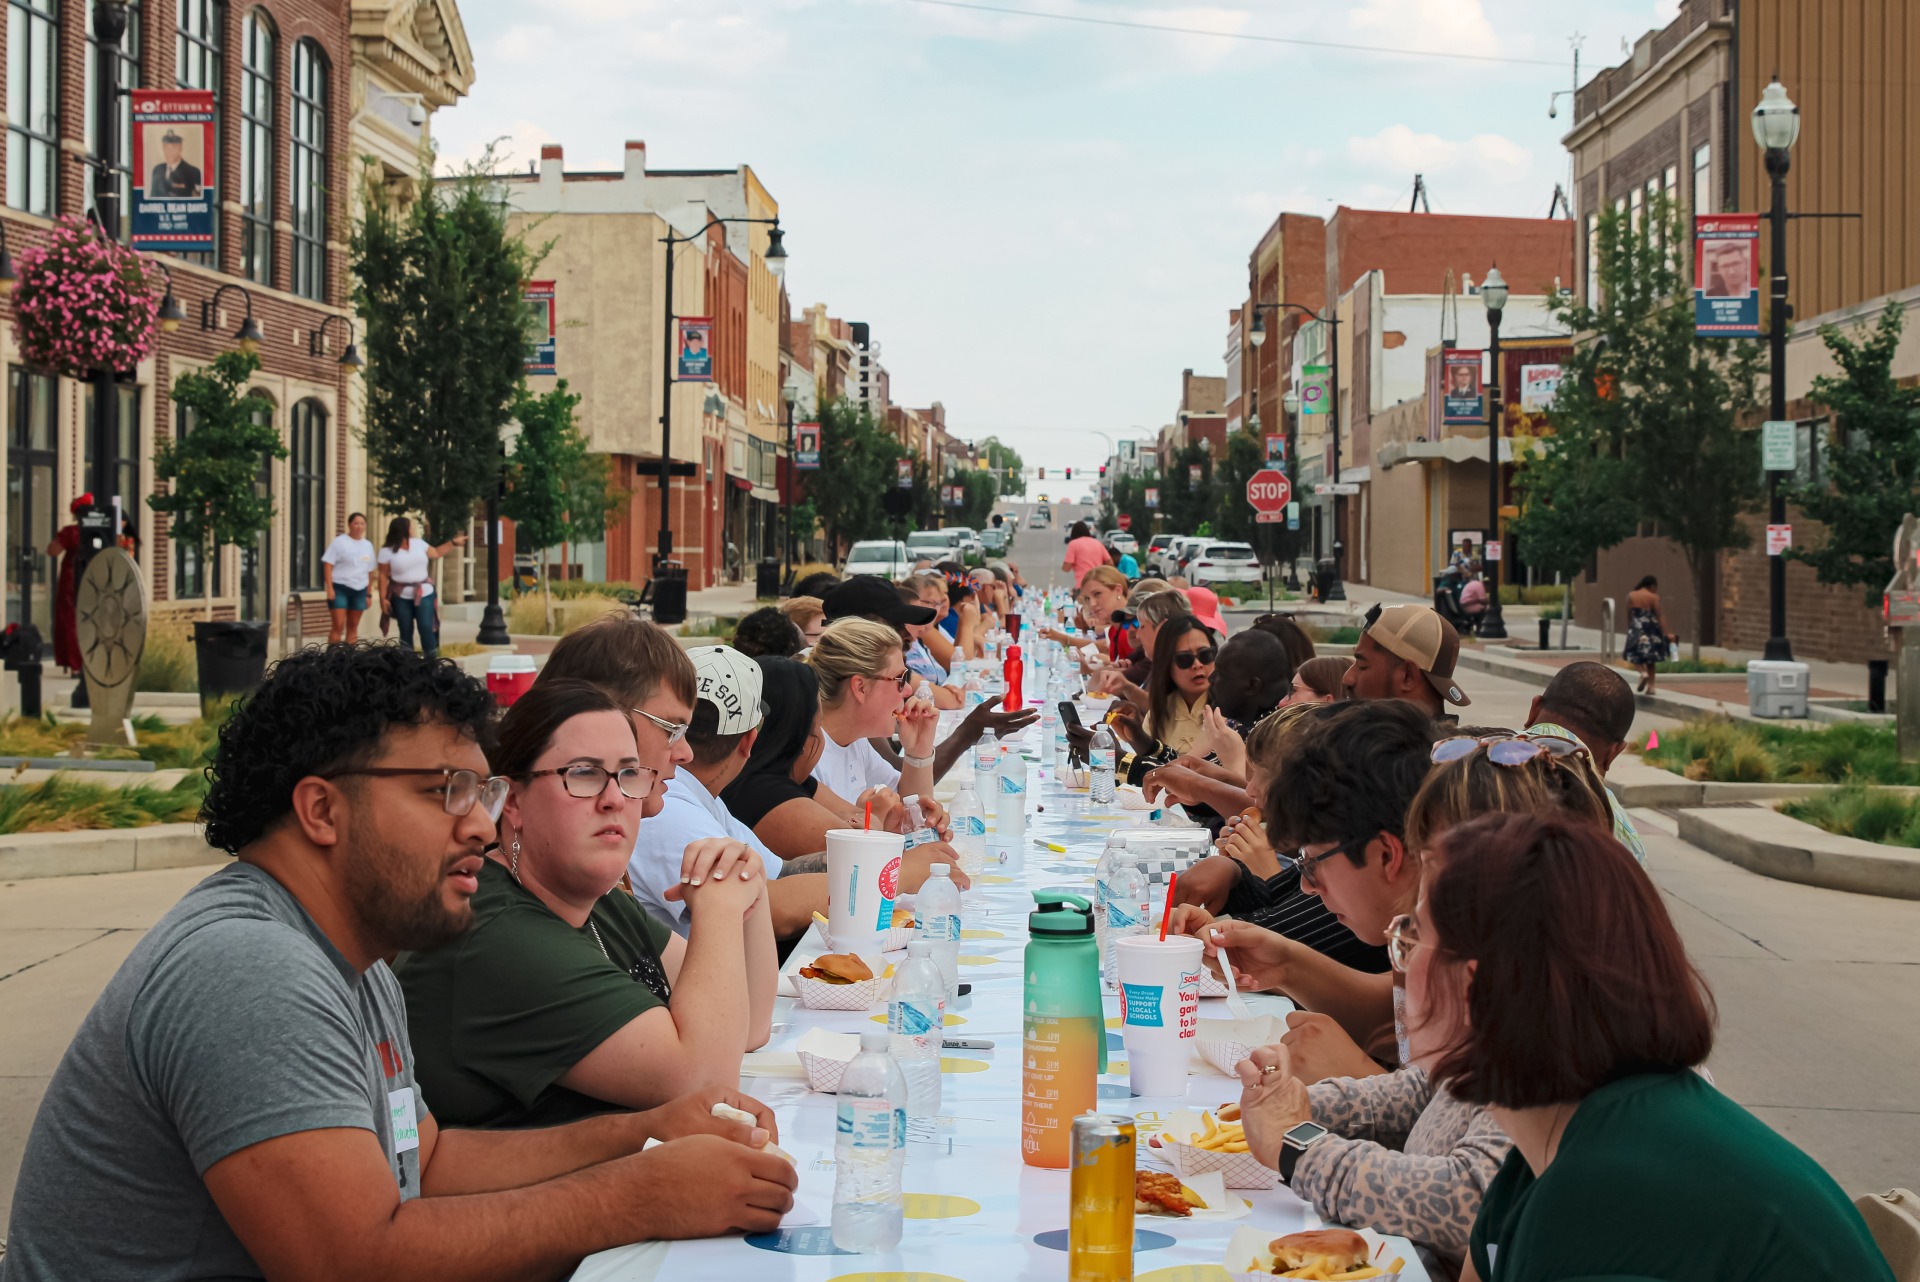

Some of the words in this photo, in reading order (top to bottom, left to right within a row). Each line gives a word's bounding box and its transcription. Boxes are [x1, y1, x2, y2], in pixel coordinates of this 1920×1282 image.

[162, 102, 202, 112] OTTUMWA
[1250, 482, 1288, 500] STOP
[715, 684, 742, 720] SOX
[1179, 991, 1194, 1002] You
[1180, 1018, 1189, 1027] to
[1046, 1061, 1059, 1070] 5PM
[1034, 1101, 1053, 1110] THERE
[1046, 1118, 1058, 1127] 7PM
